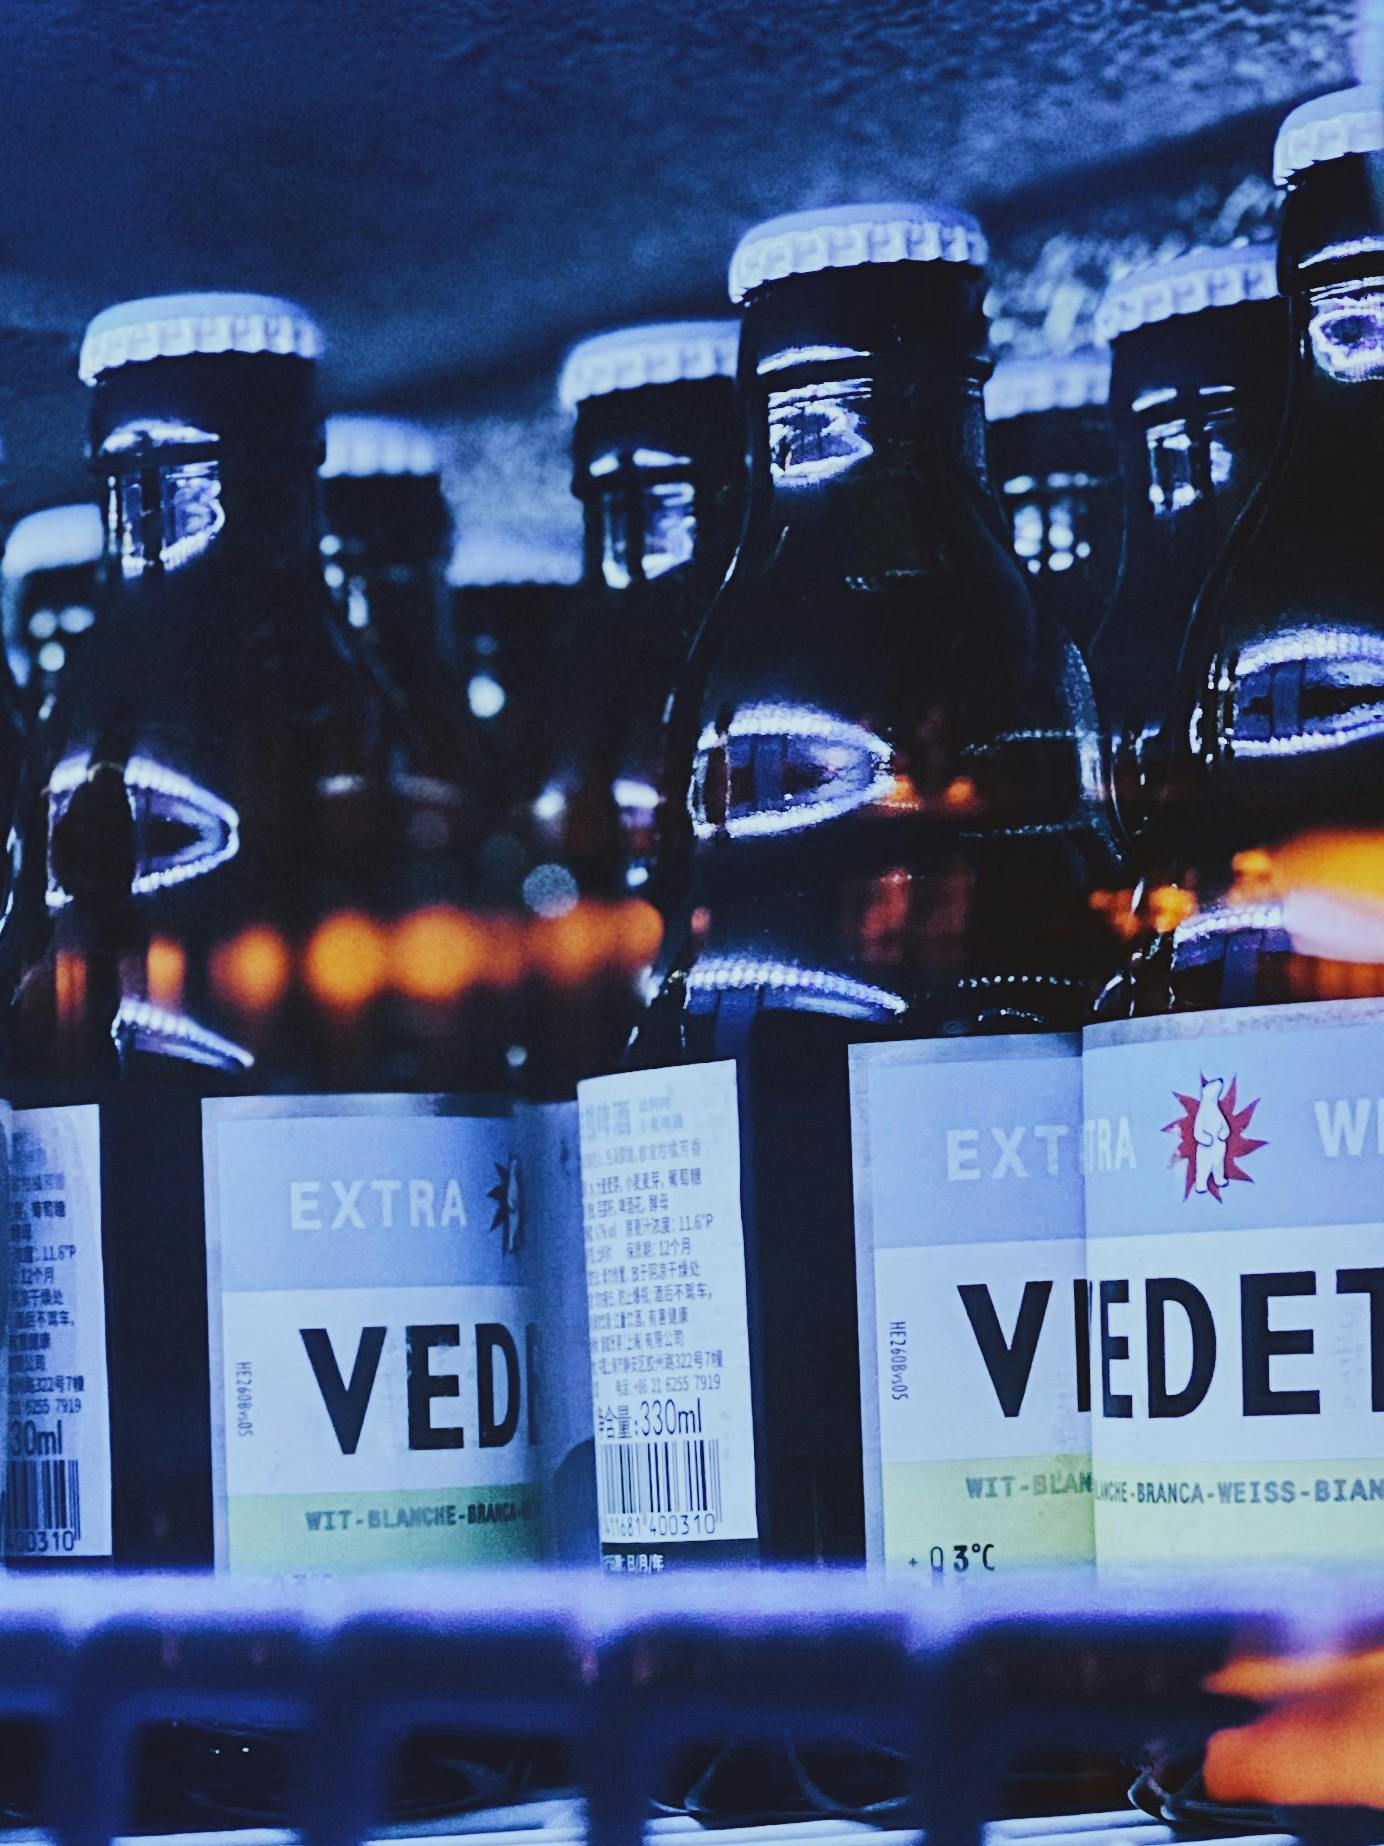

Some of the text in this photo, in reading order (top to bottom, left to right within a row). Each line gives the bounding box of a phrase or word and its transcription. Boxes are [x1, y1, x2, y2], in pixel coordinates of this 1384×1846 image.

[1083, 1114, 1137, 1175] TRA
[1314, 1098, 1384, 1159] W
[290, 1178, 468, 1232] EXTRA
[956, 1279, 1090, 1418] V
[694, 1372, 721, 1391] 7919
[648, 1512, 717, 1537] 400310
